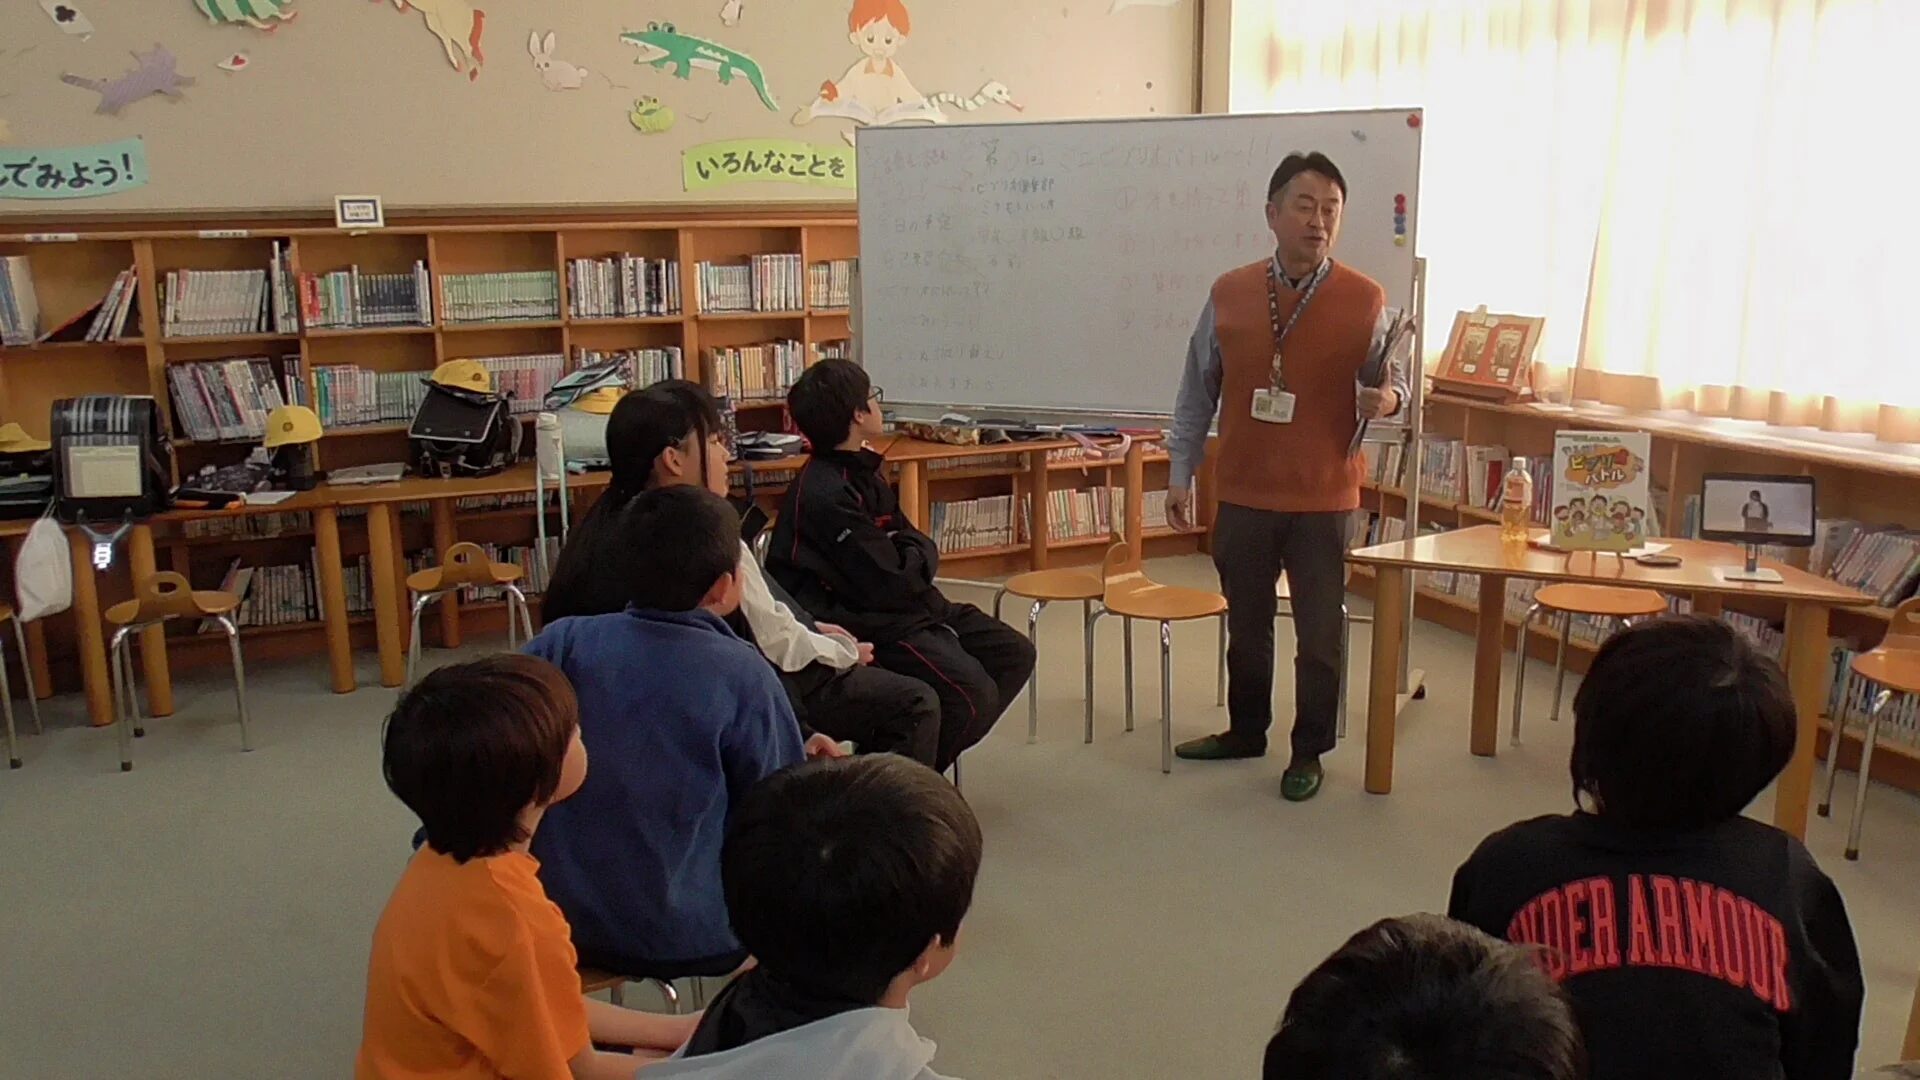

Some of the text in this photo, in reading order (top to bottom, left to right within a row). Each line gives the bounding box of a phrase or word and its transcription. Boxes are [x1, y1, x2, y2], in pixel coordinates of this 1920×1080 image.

[0, 153, 134, 189] でみよう!
[695, 150, 846, 180] いろんなことを
[1627, 874, 1792, 1012] ARMOUR
